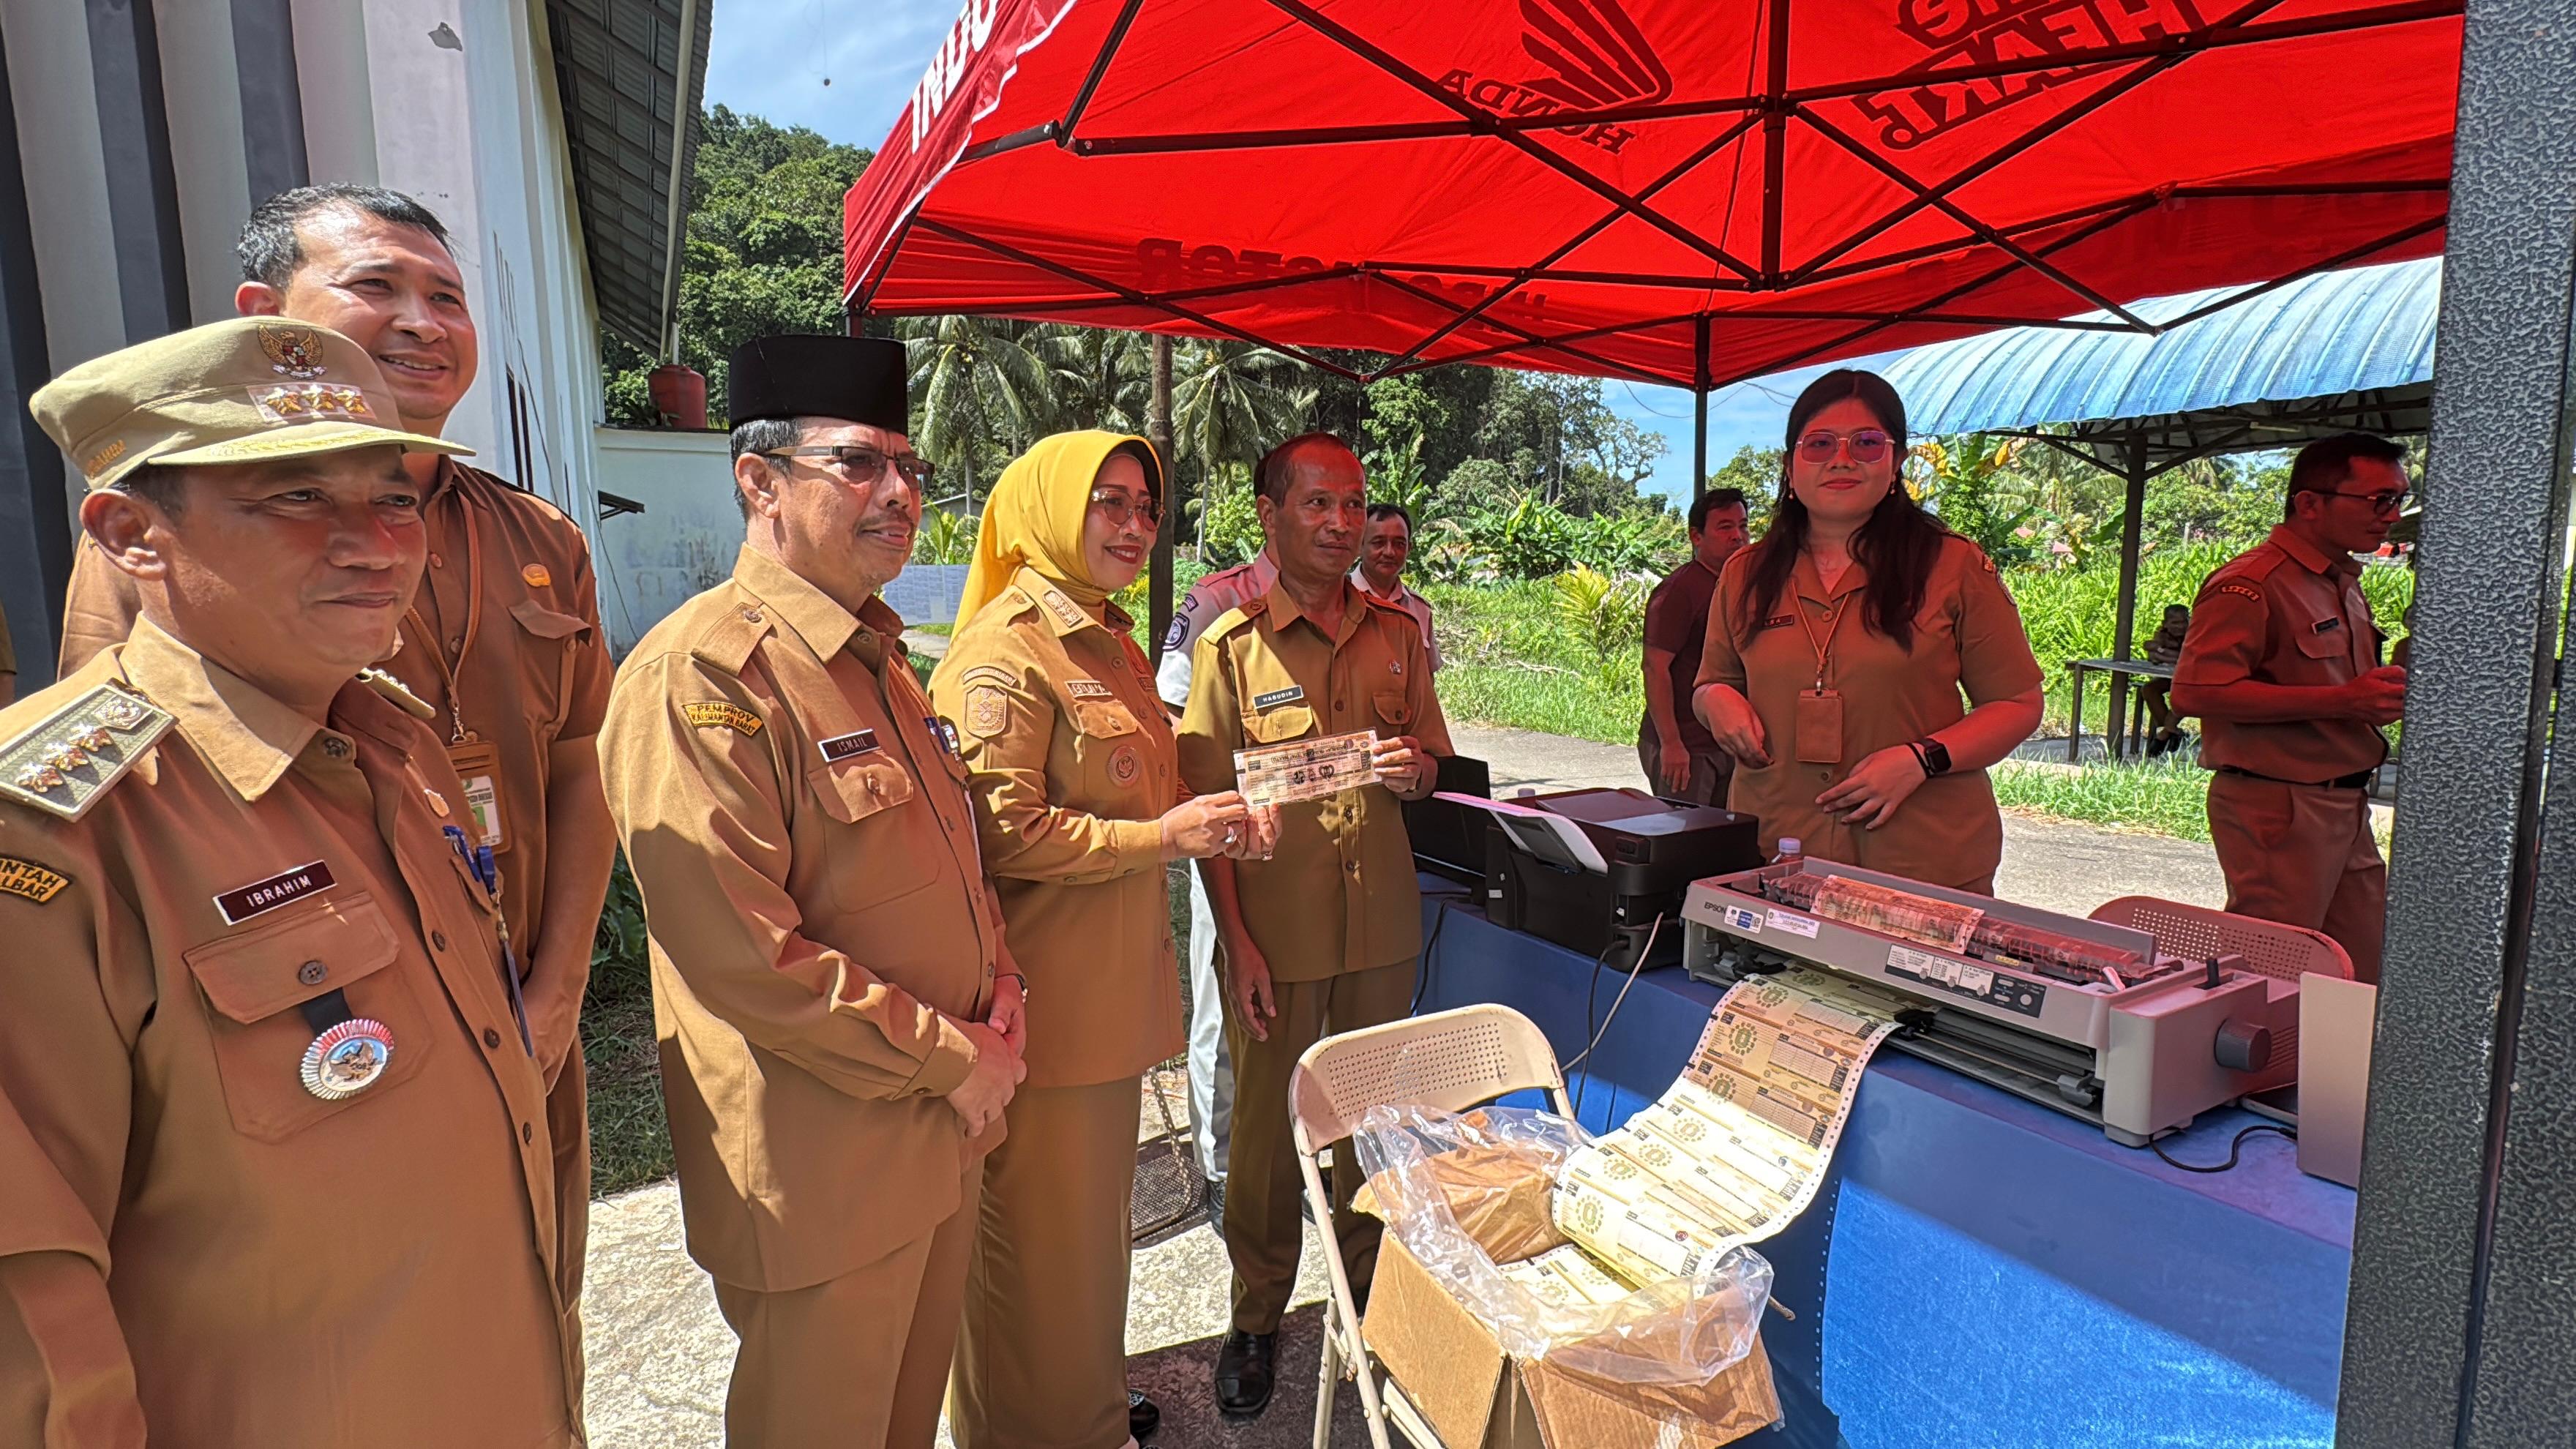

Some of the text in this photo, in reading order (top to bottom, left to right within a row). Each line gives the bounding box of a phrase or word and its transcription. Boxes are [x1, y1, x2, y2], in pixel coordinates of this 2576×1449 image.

[696, 703, 755, 722] PEMPROV
[836, 736, 867, 752] ISMAIL
[246, 874, 312, 907] IBRAHIM
[1704, 902, 1726, 915] EPSON
